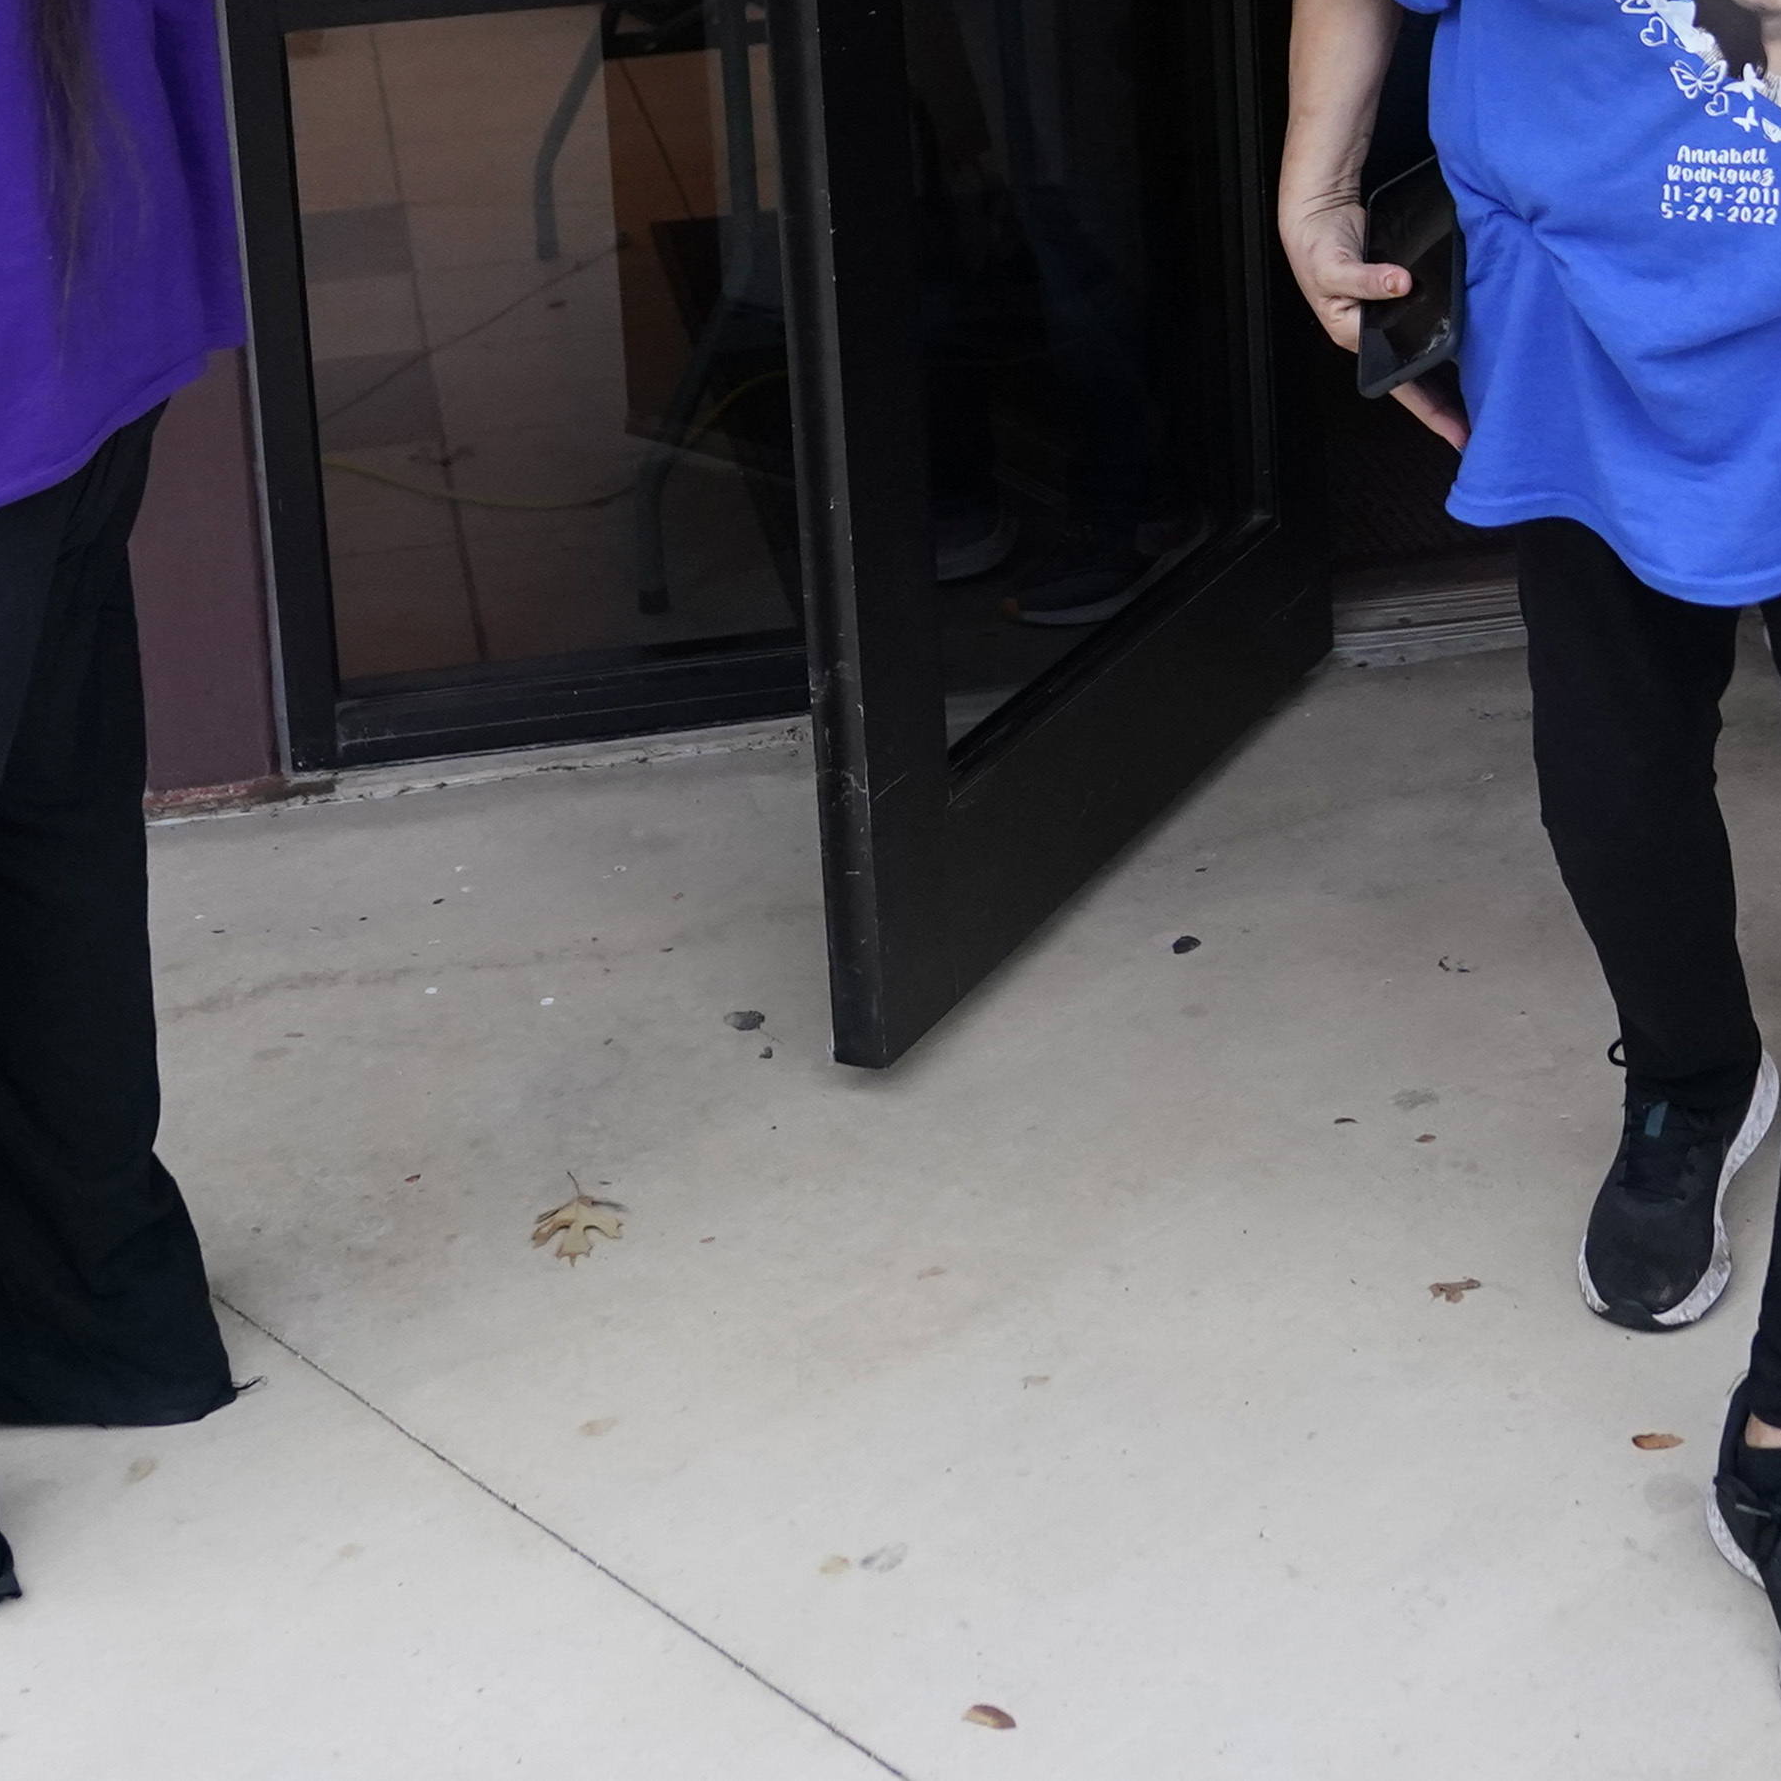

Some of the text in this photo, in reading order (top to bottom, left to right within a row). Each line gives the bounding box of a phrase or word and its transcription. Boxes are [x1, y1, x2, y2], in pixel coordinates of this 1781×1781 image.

[1677, 144, 1768, 165] Annabell
[1667, 163, 1775, 187] Rodriguez
[1662, 183, 1780, 206] 11-29-2011
[1660, 201, 1779, 226] 5-24-2022
